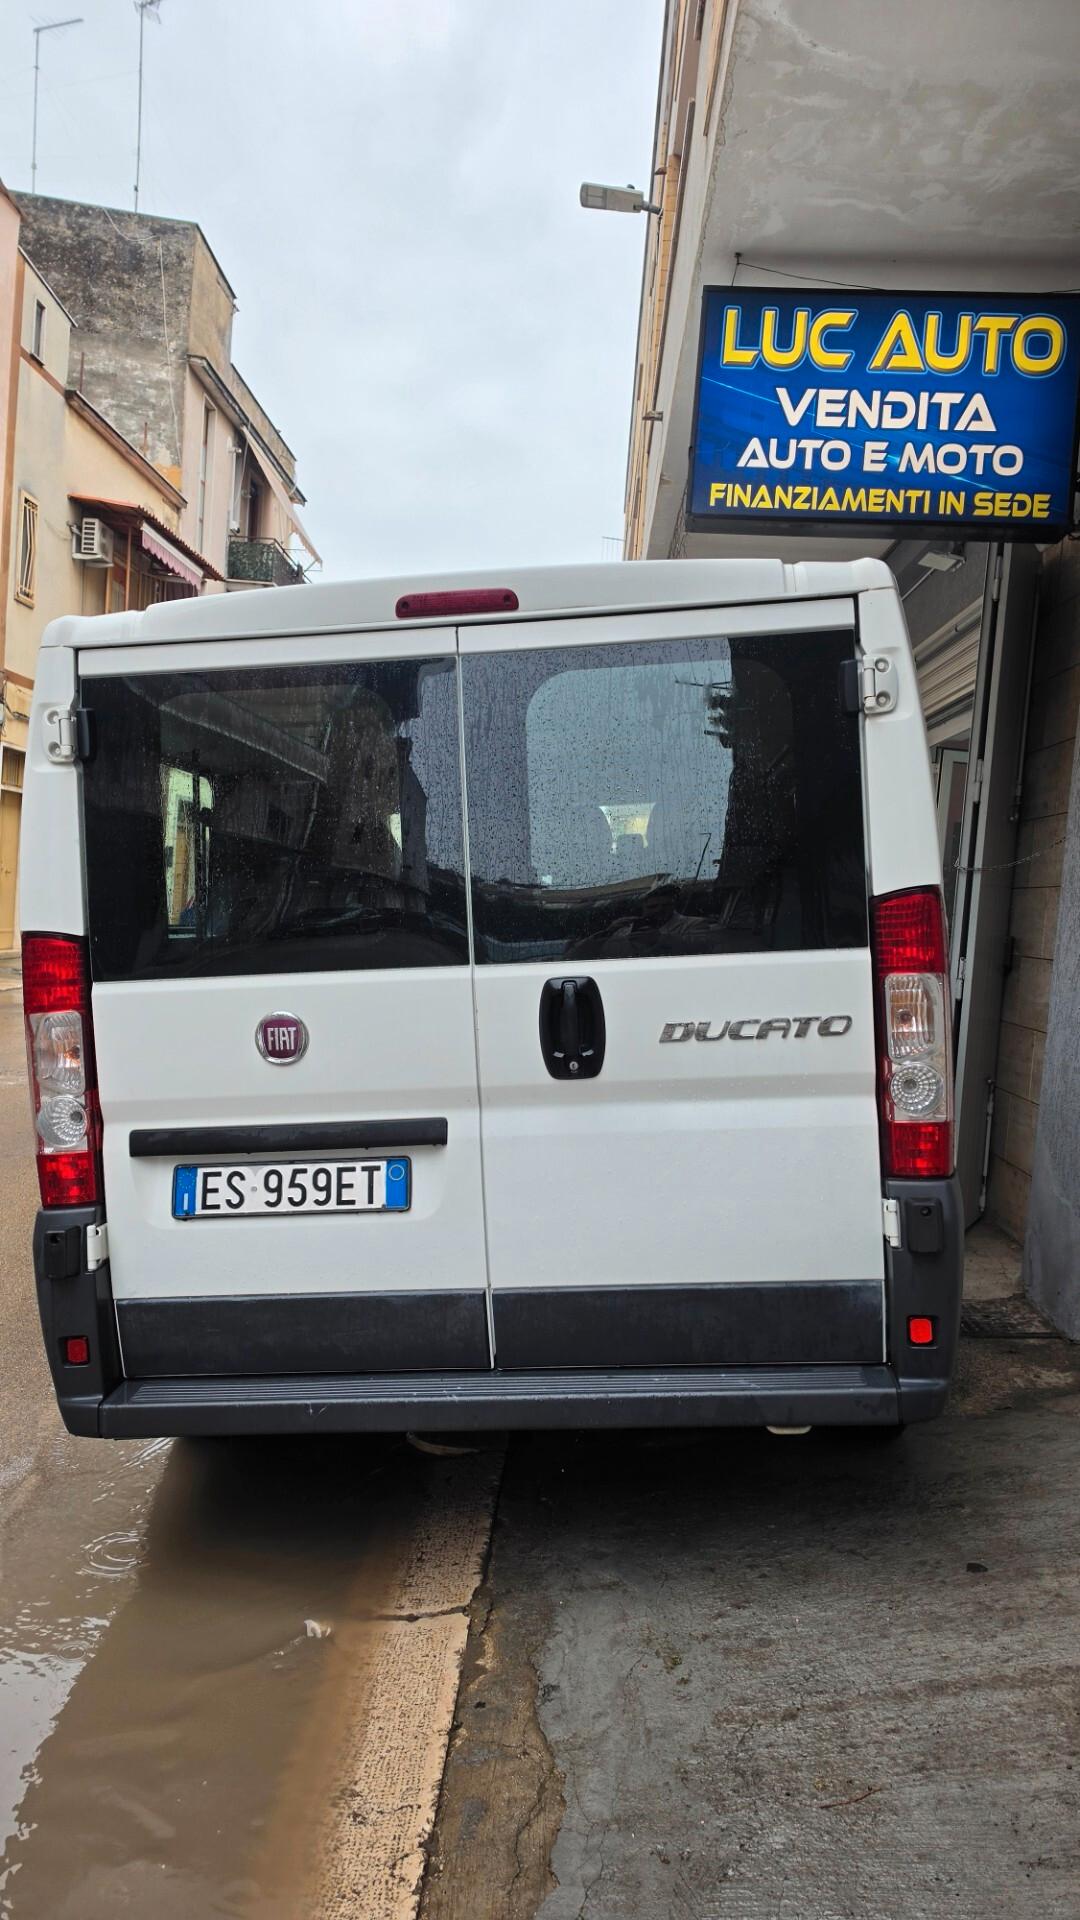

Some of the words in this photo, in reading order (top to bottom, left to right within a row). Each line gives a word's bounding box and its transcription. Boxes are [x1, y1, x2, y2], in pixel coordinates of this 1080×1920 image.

[721, 306, 858, 372] LUC
[867, 309, 1067, 379] AUTO
[776, 388, 997, 431] VENDITA
[737, 437, 851, 470] AUTO
[862, 442, 889, 472] E
[898, 443, 1024, 476] MOTO
[709, 483, 930, 514] FINANZIAMENTI
[938, 491, 965, 515] IN
[973, 493, 1052, 518] SEDE
[267, 1027, 297, 1050] FIAT
[659, 1015, 853, 1043] DUCATO
[201, 1170, 246, 1210] ES
[263, 1165, 381, 1207] 959ET
